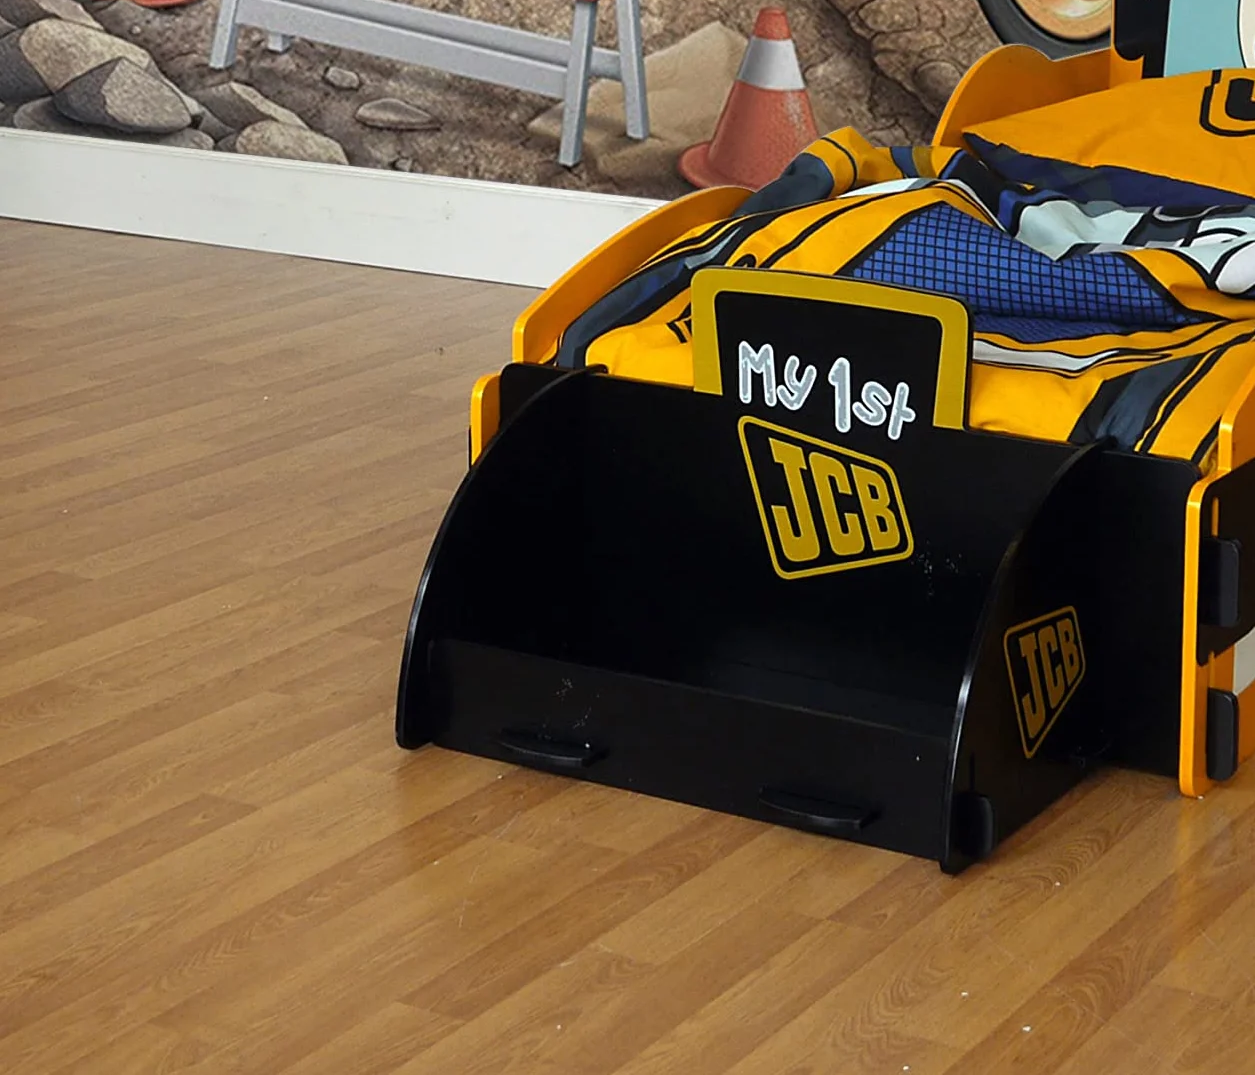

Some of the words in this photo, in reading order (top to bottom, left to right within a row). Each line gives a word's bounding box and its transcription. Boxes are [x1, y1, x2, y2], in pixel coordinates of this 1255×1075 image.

[739, 340, 817, 411] My
[828, 357, 916, 440] 1st
[768, 437, 900, 562] JCB
[1019, 618, 1080, 739] JCB
